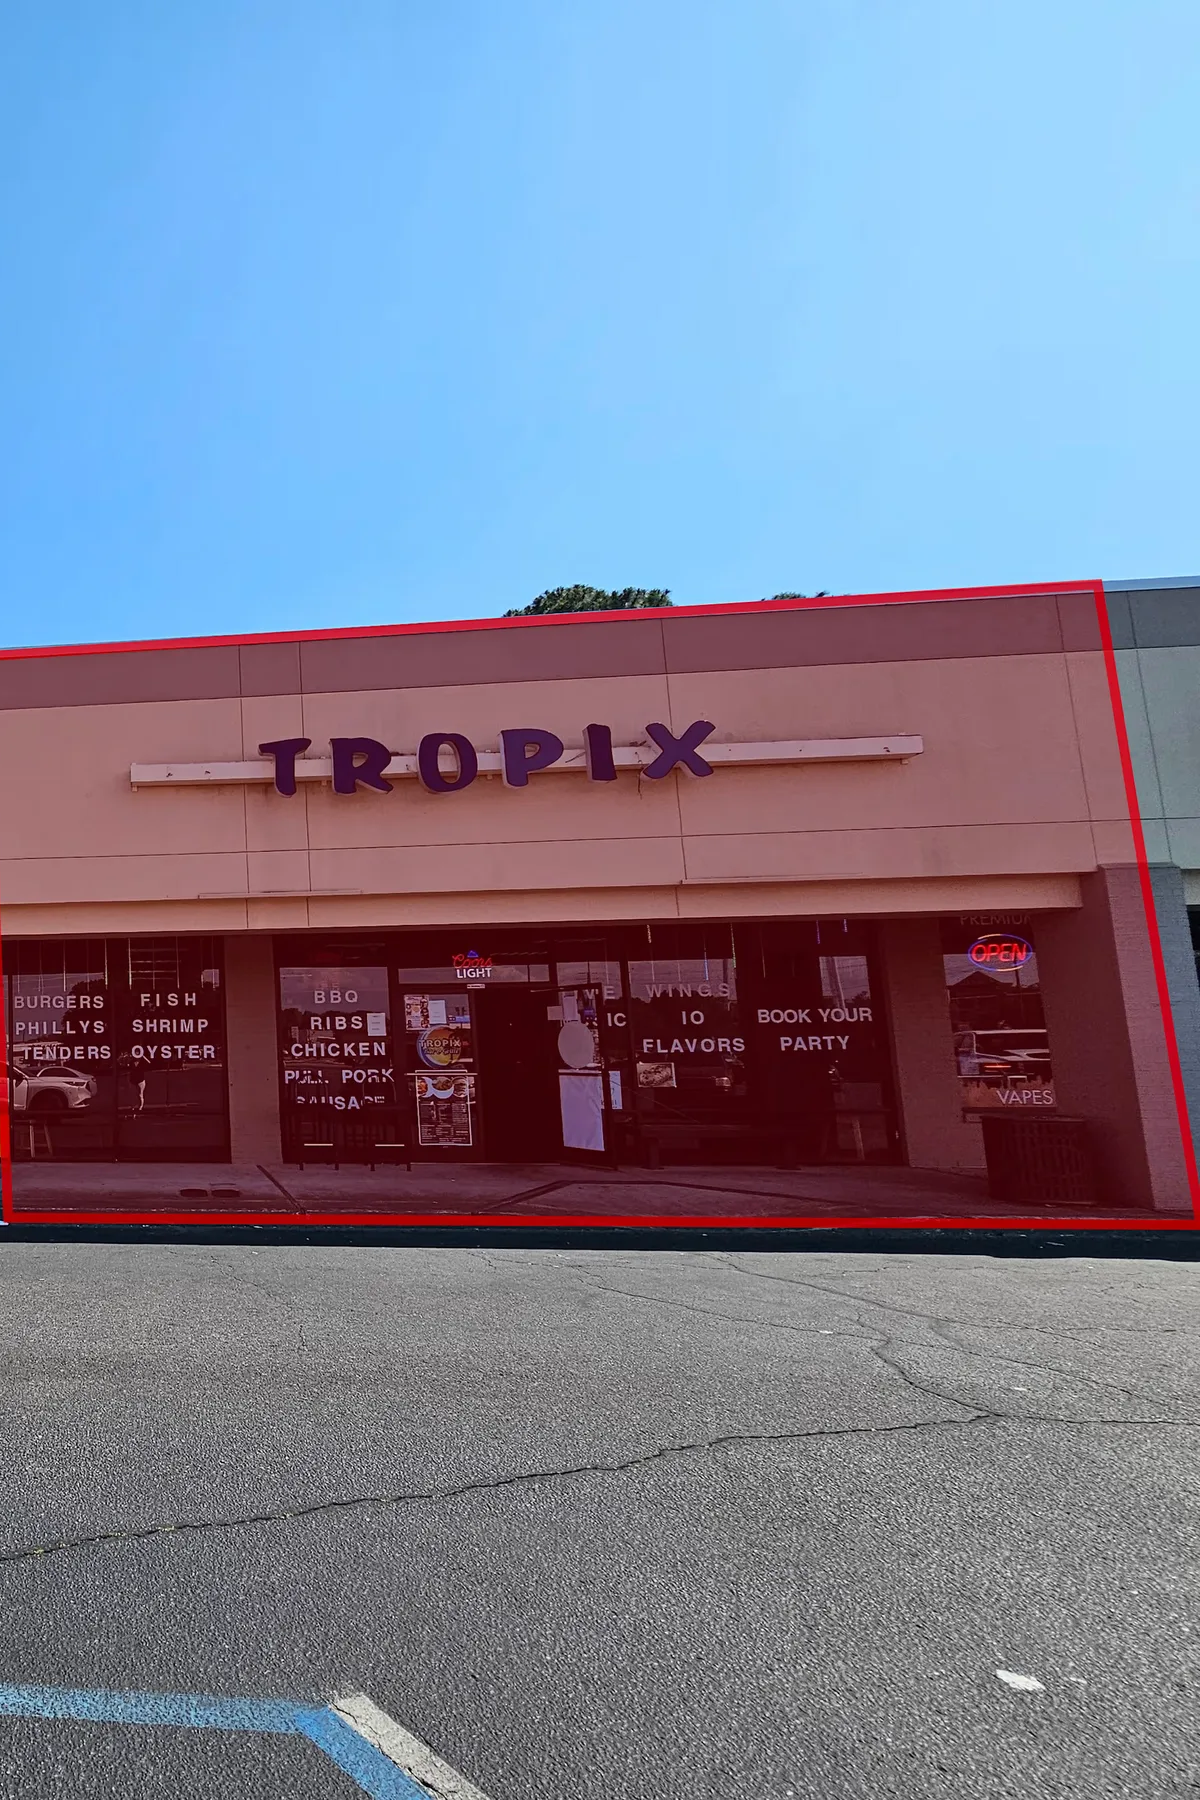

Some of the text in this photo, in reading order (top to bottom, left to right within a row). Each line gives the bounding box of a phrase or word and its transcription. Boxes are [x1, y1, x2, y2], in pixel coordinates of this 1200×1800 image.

[258, 720, 716, 797] TROPIX
[971, 943, 1027, 962] OPEN
[452, 954, 492, 968] Coors
[456, 968, 492, 979] LIGHT
[314, 990, 359, 1004] BBQ
[645, 983, 731, 998] WINGS
[14, 995, 104, 1009] BURGERS
[140, 992, 197, 1007] FISH
[310, 1015, 363, 1030] RIBS
[757, 1007, 873, 1023] BOOK YOUR
[15, 1020, 105, 1035] PHILLYS
[132, 1018, 209, 1033] SHRIMP
[291, 1041, 386, 1057] CHICKEN
[419, 1038, 461, 1047] TROPIX
[642, 1037, 745, 1053] FLAVORS
[779, 1035, 850, 1051] PARTY
[24, 1045, 111, 1060] TENDERS
[131, 1044, 216, 1059] OYSTER
[341, 1068, 395, 1083] PORK
[996, 1090, 1053, 1105] VAPES
